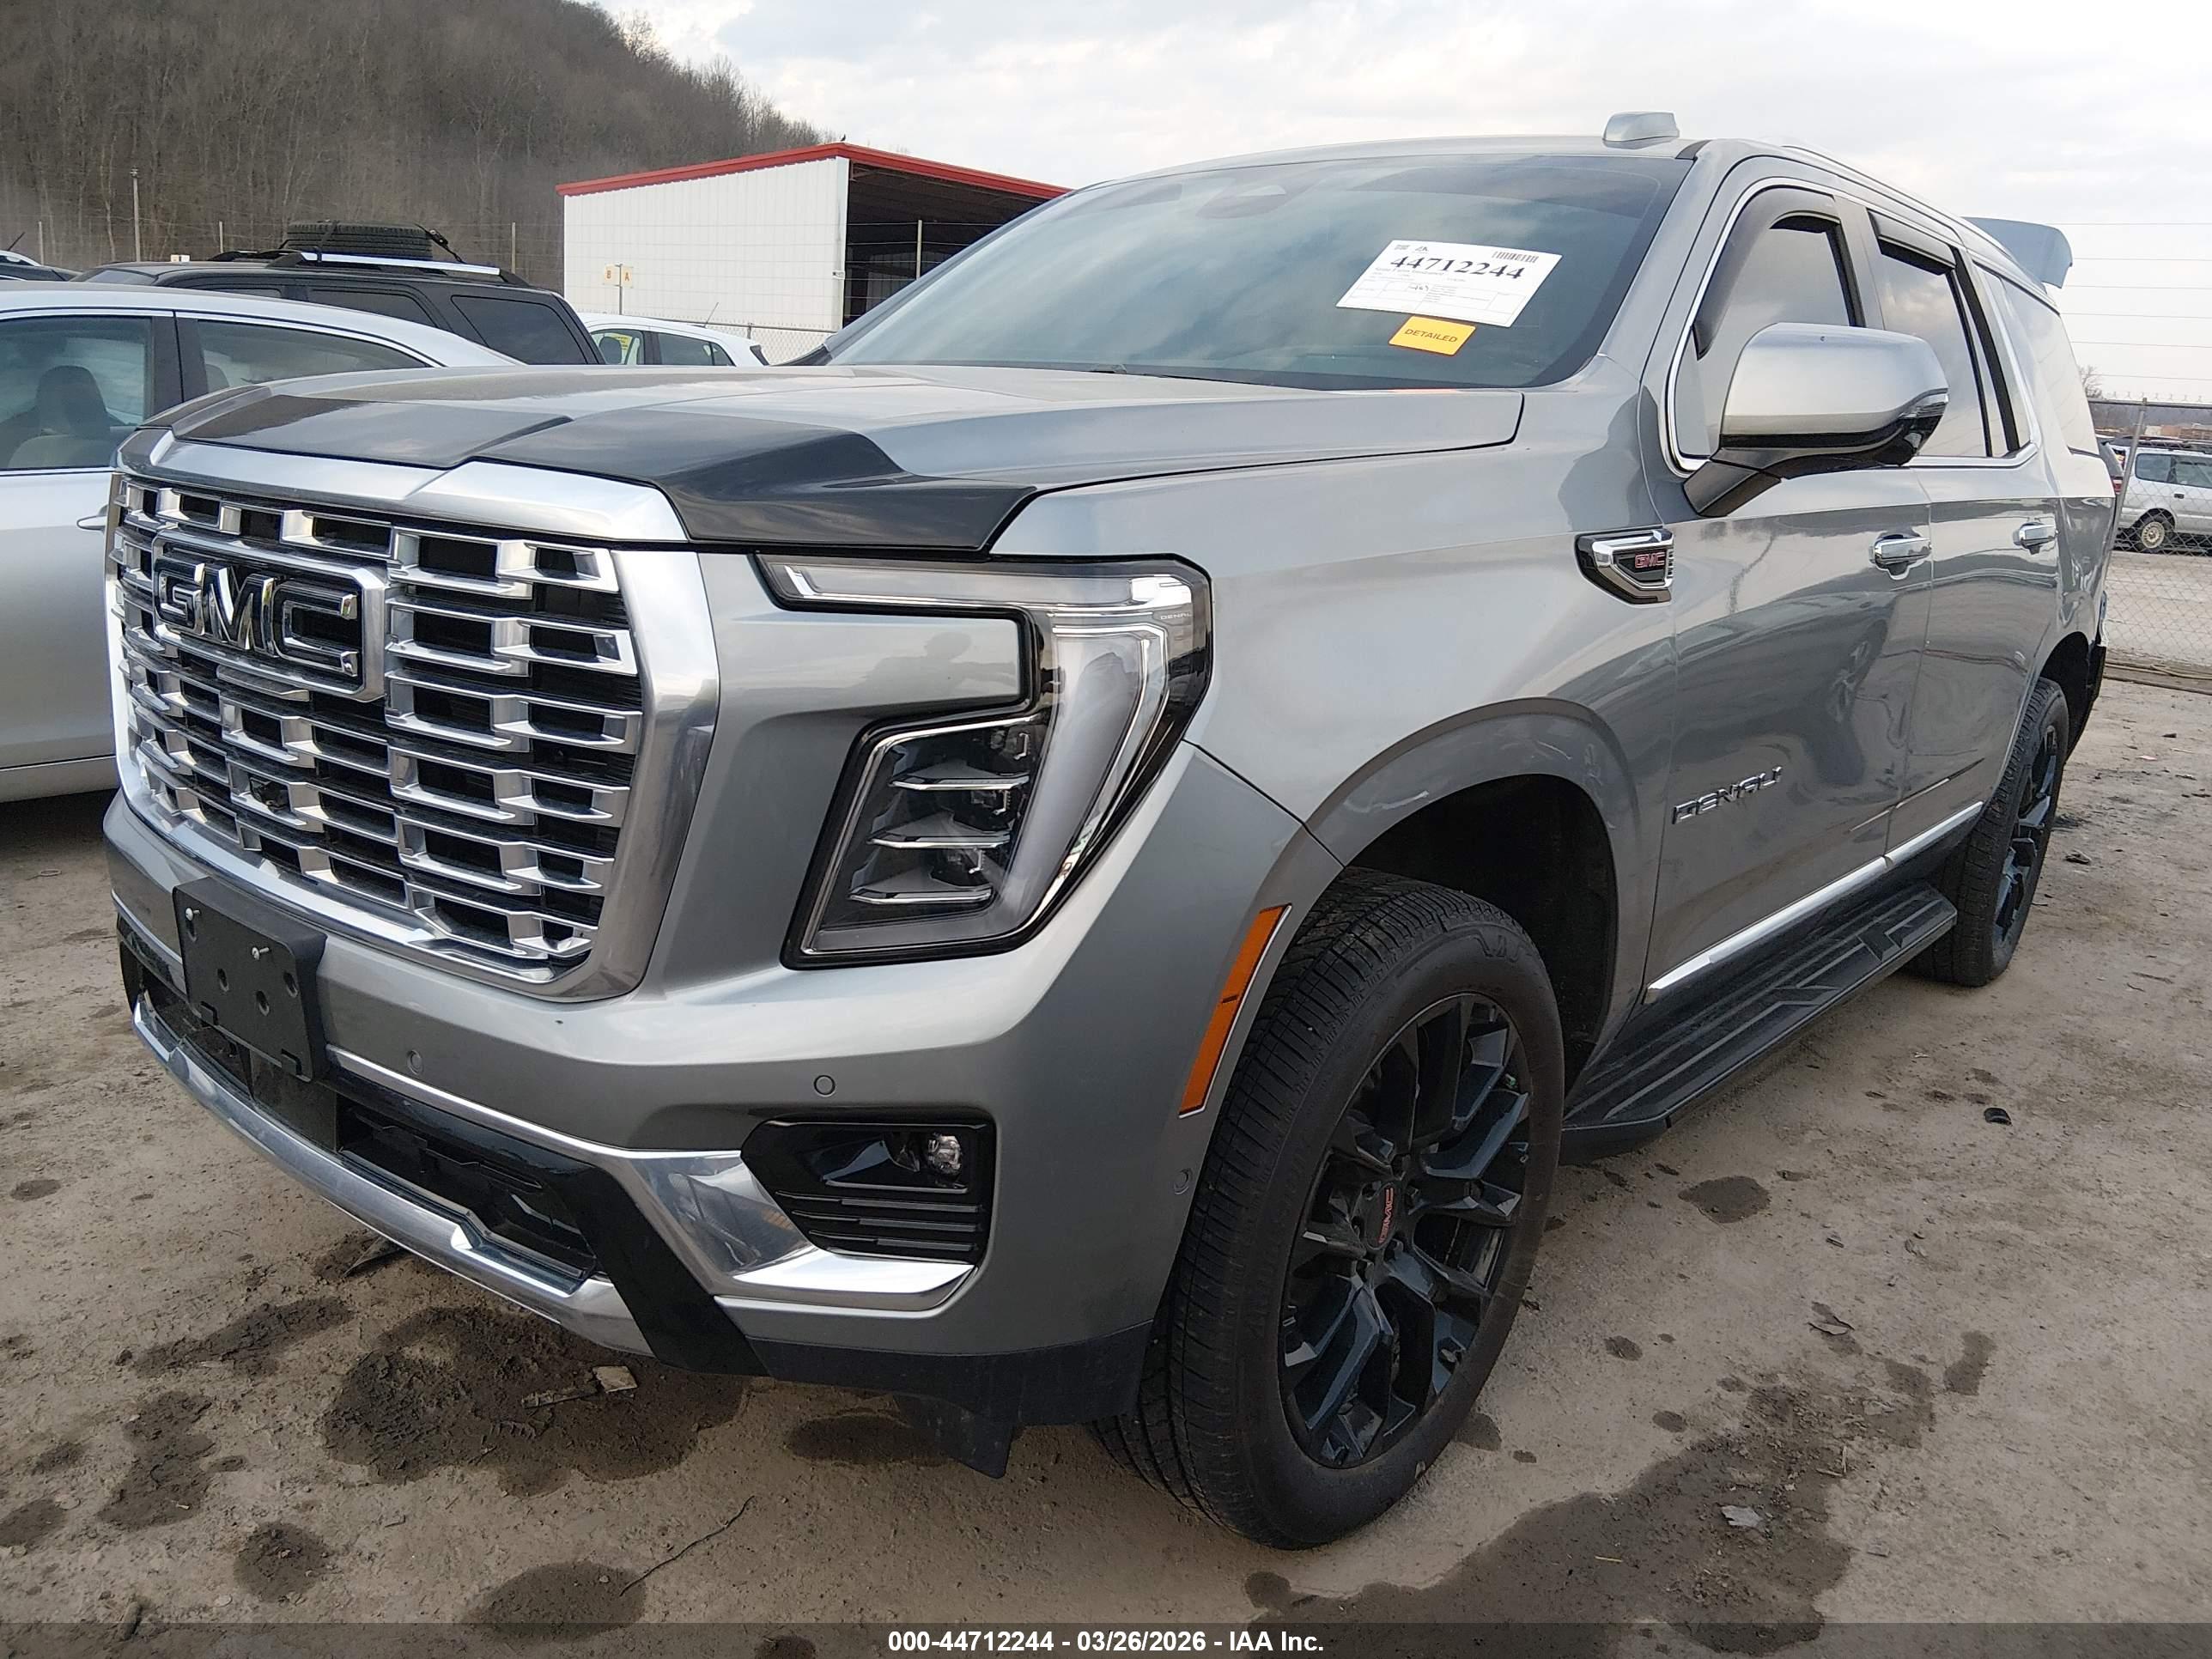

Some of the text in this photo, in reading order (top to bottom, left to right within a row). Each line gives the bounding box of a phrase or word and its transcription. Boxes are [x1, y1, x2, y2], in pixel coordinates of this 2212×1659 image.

[624, 271, 630, 282] A
[1389, 256, 1526, 279] 44712244
[1404, 328, 1458, 343] DETAILED
[1634, 551, 1666, 568] GMC
[153, 558, 359, 678] GMC
[1160, 611, 1193, 620] DENAL
[1672, 766, 1783, 824] DENALI
[1377, 1187, 1394, 1244] GMC
